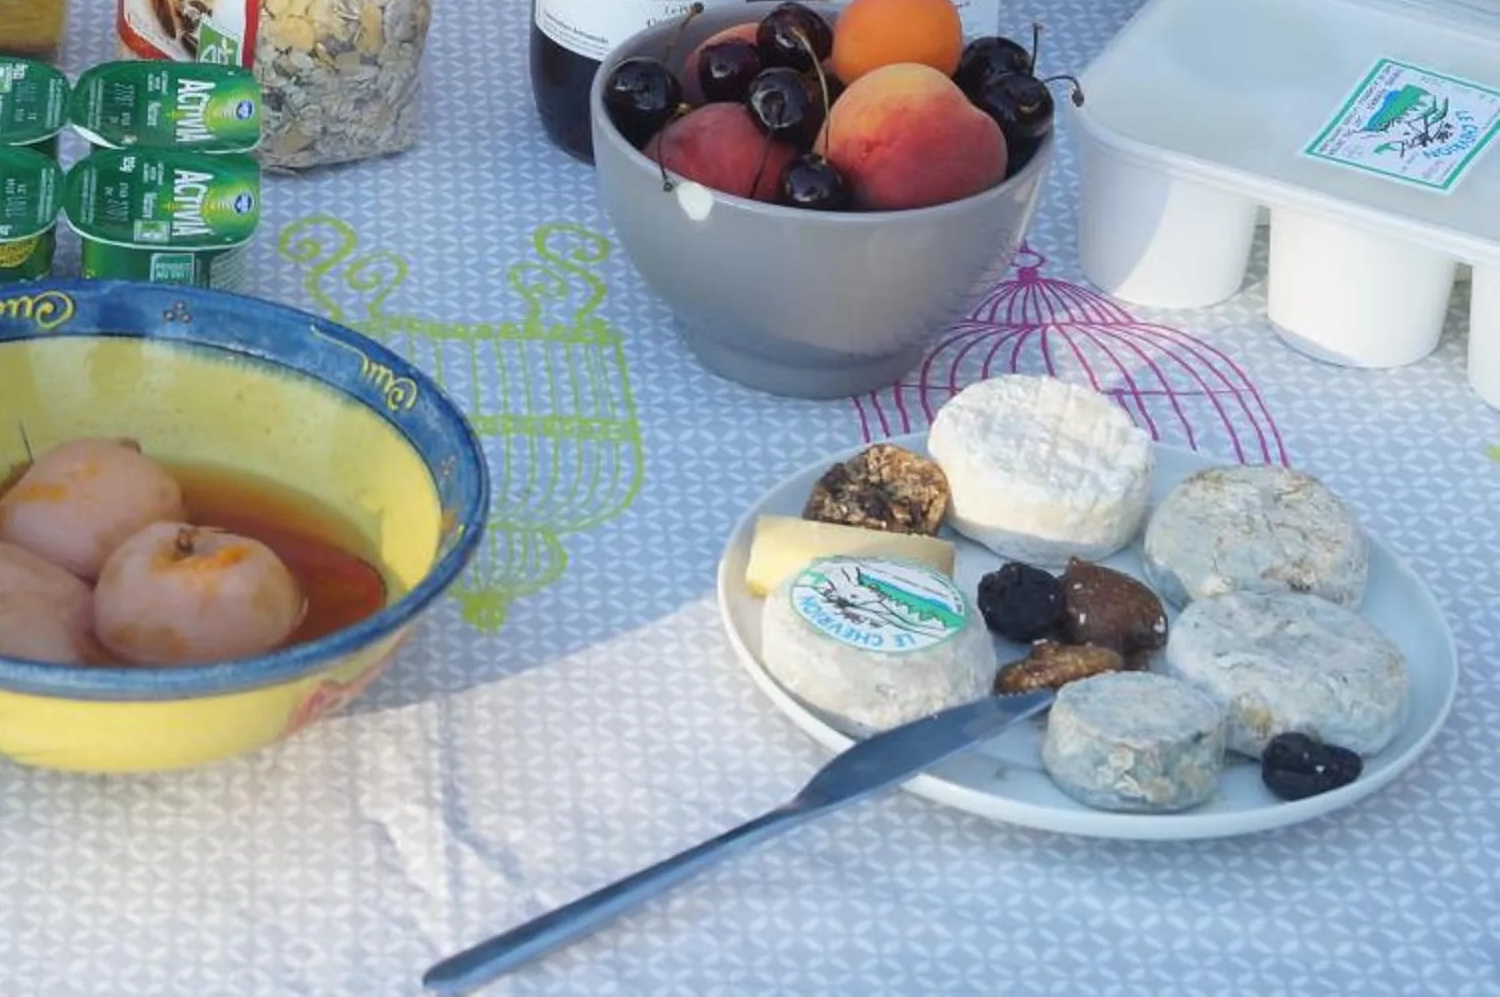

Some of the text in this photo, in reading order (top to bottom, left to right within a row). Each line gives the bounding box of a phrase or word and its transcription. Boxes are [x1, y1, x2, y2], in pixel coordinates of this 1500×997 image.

[175, 78, 217, 143] ACTIVIA
[172, 169, 215, 237] ACTIVIA
[893, 632, 917, 648] LE
